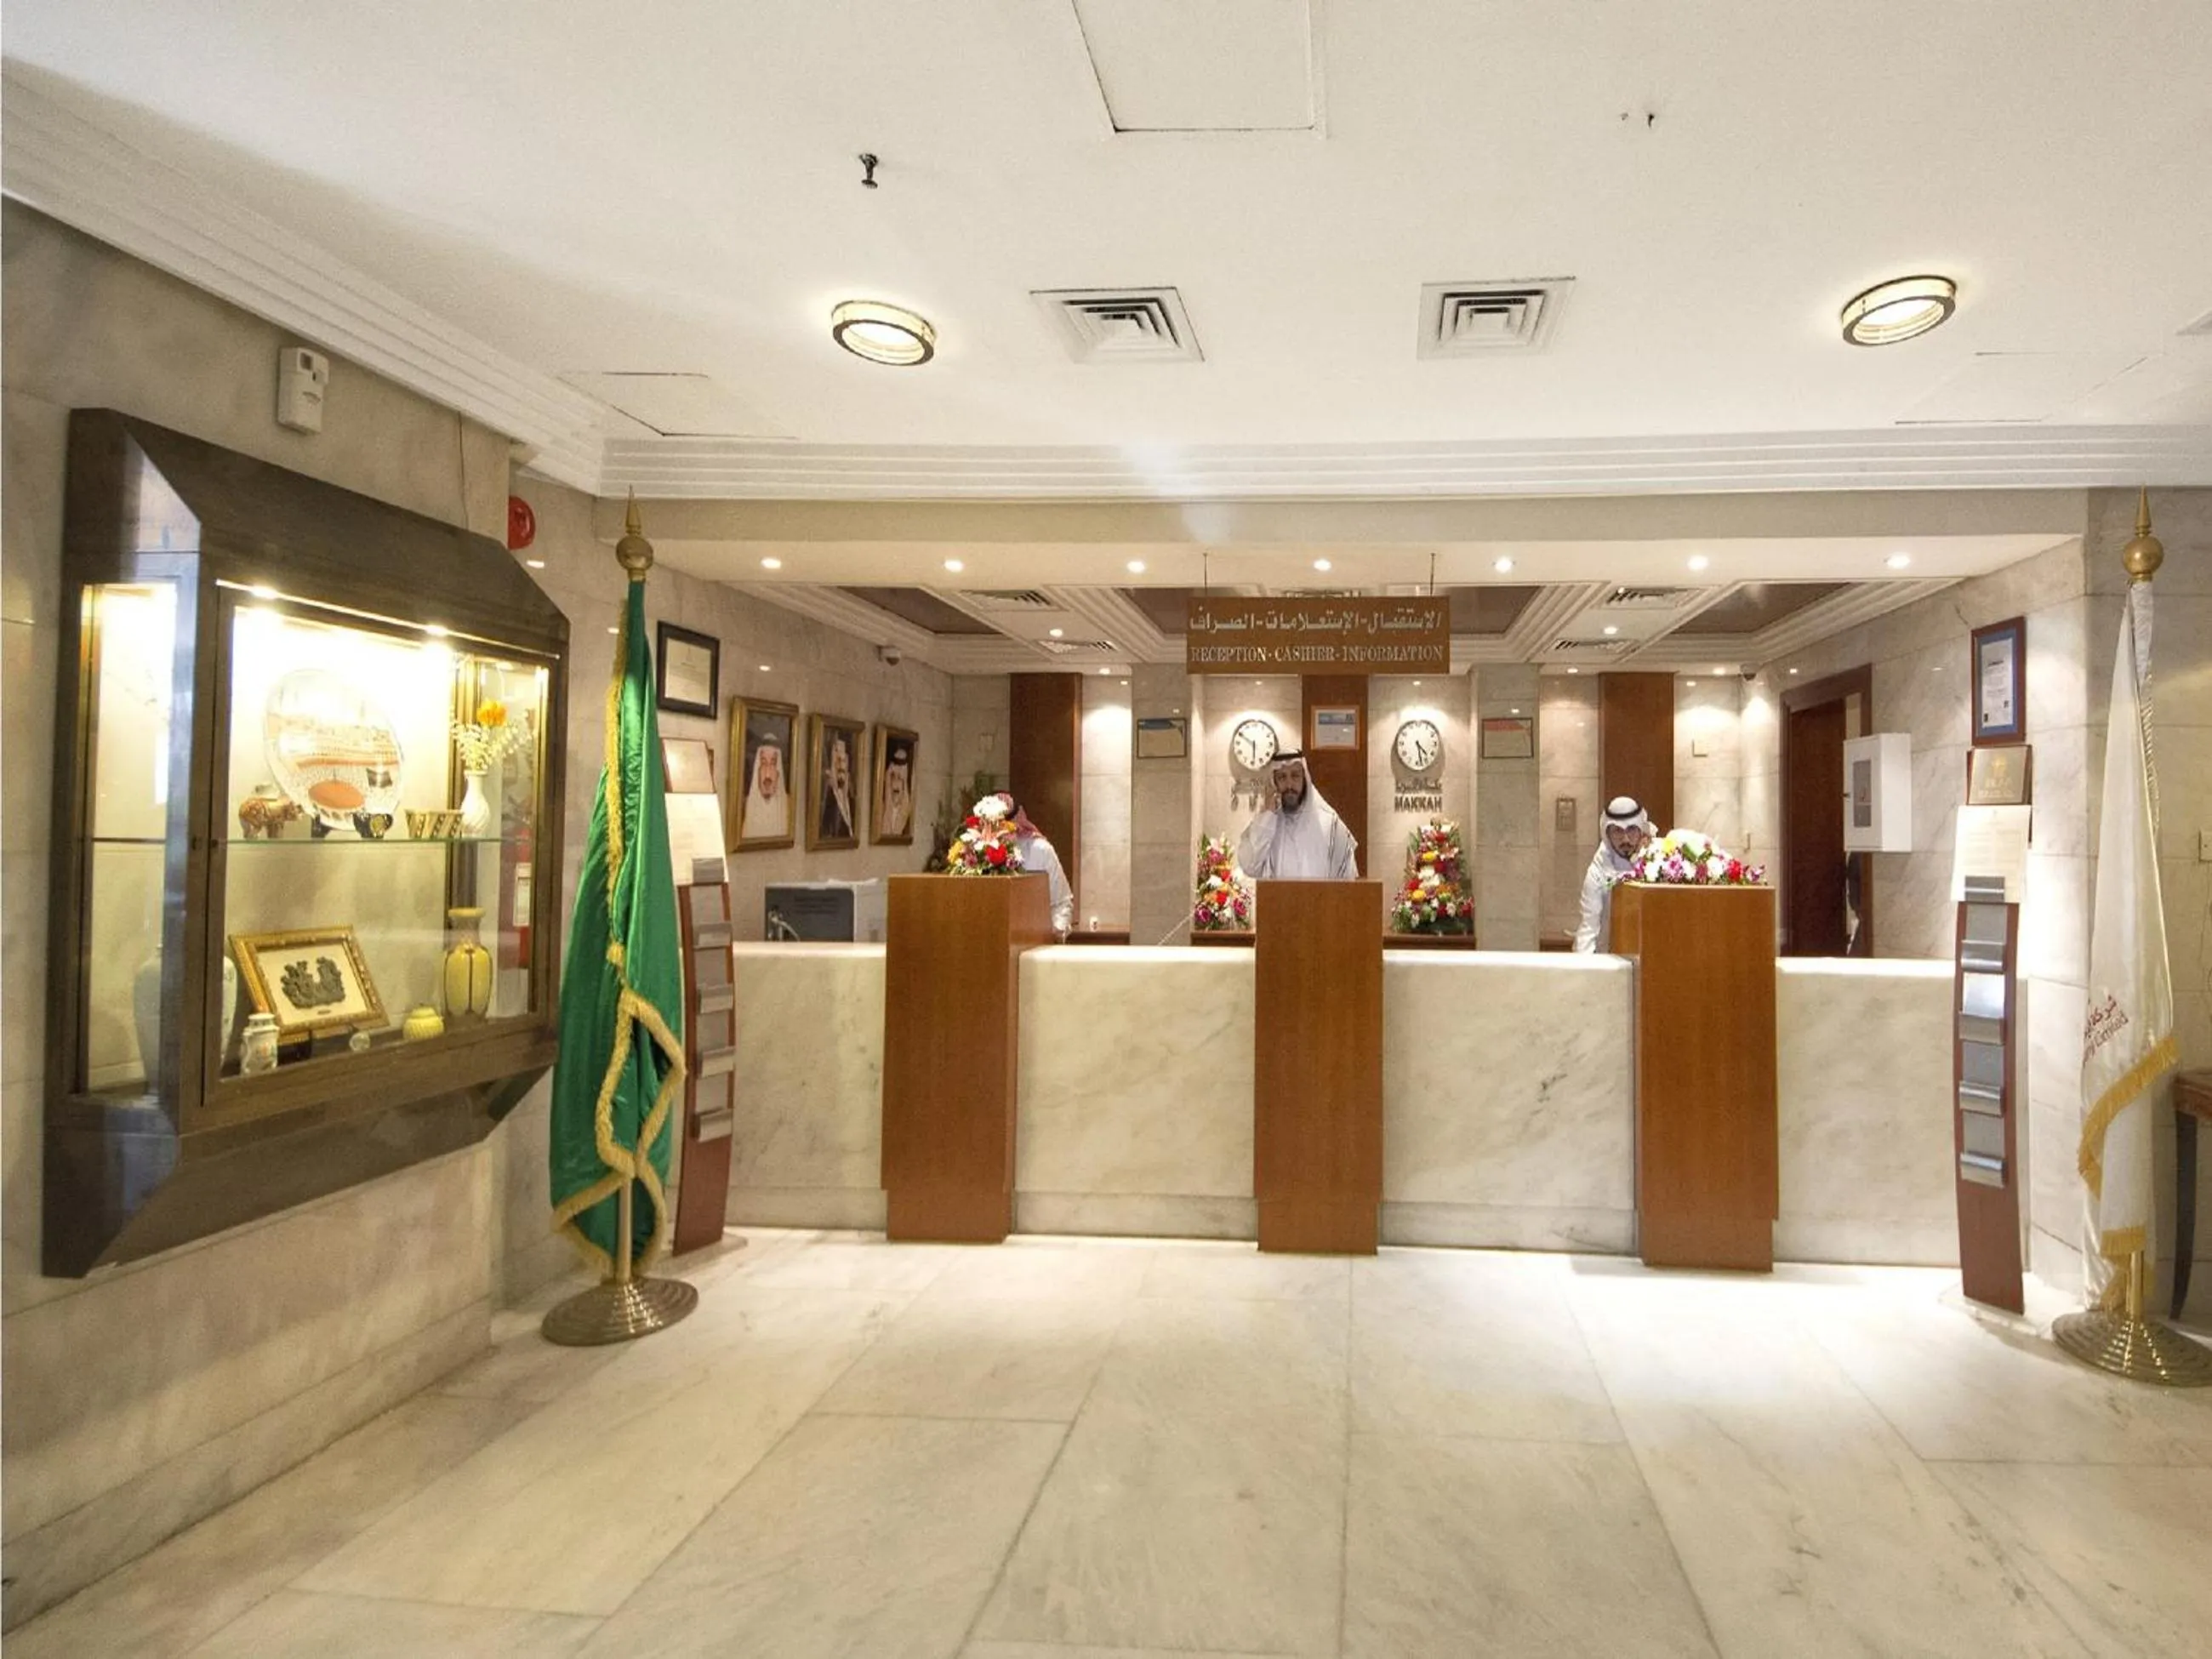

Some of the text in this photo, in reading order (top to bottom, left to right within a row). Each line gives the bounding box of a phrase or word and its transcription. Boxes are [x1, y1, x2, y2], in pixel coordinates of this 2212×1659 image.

[1190, 645, 1444, 662] RECEPTION CASHIER INFORMATION
[1394, 795, 1443, 812] MAKKAH
